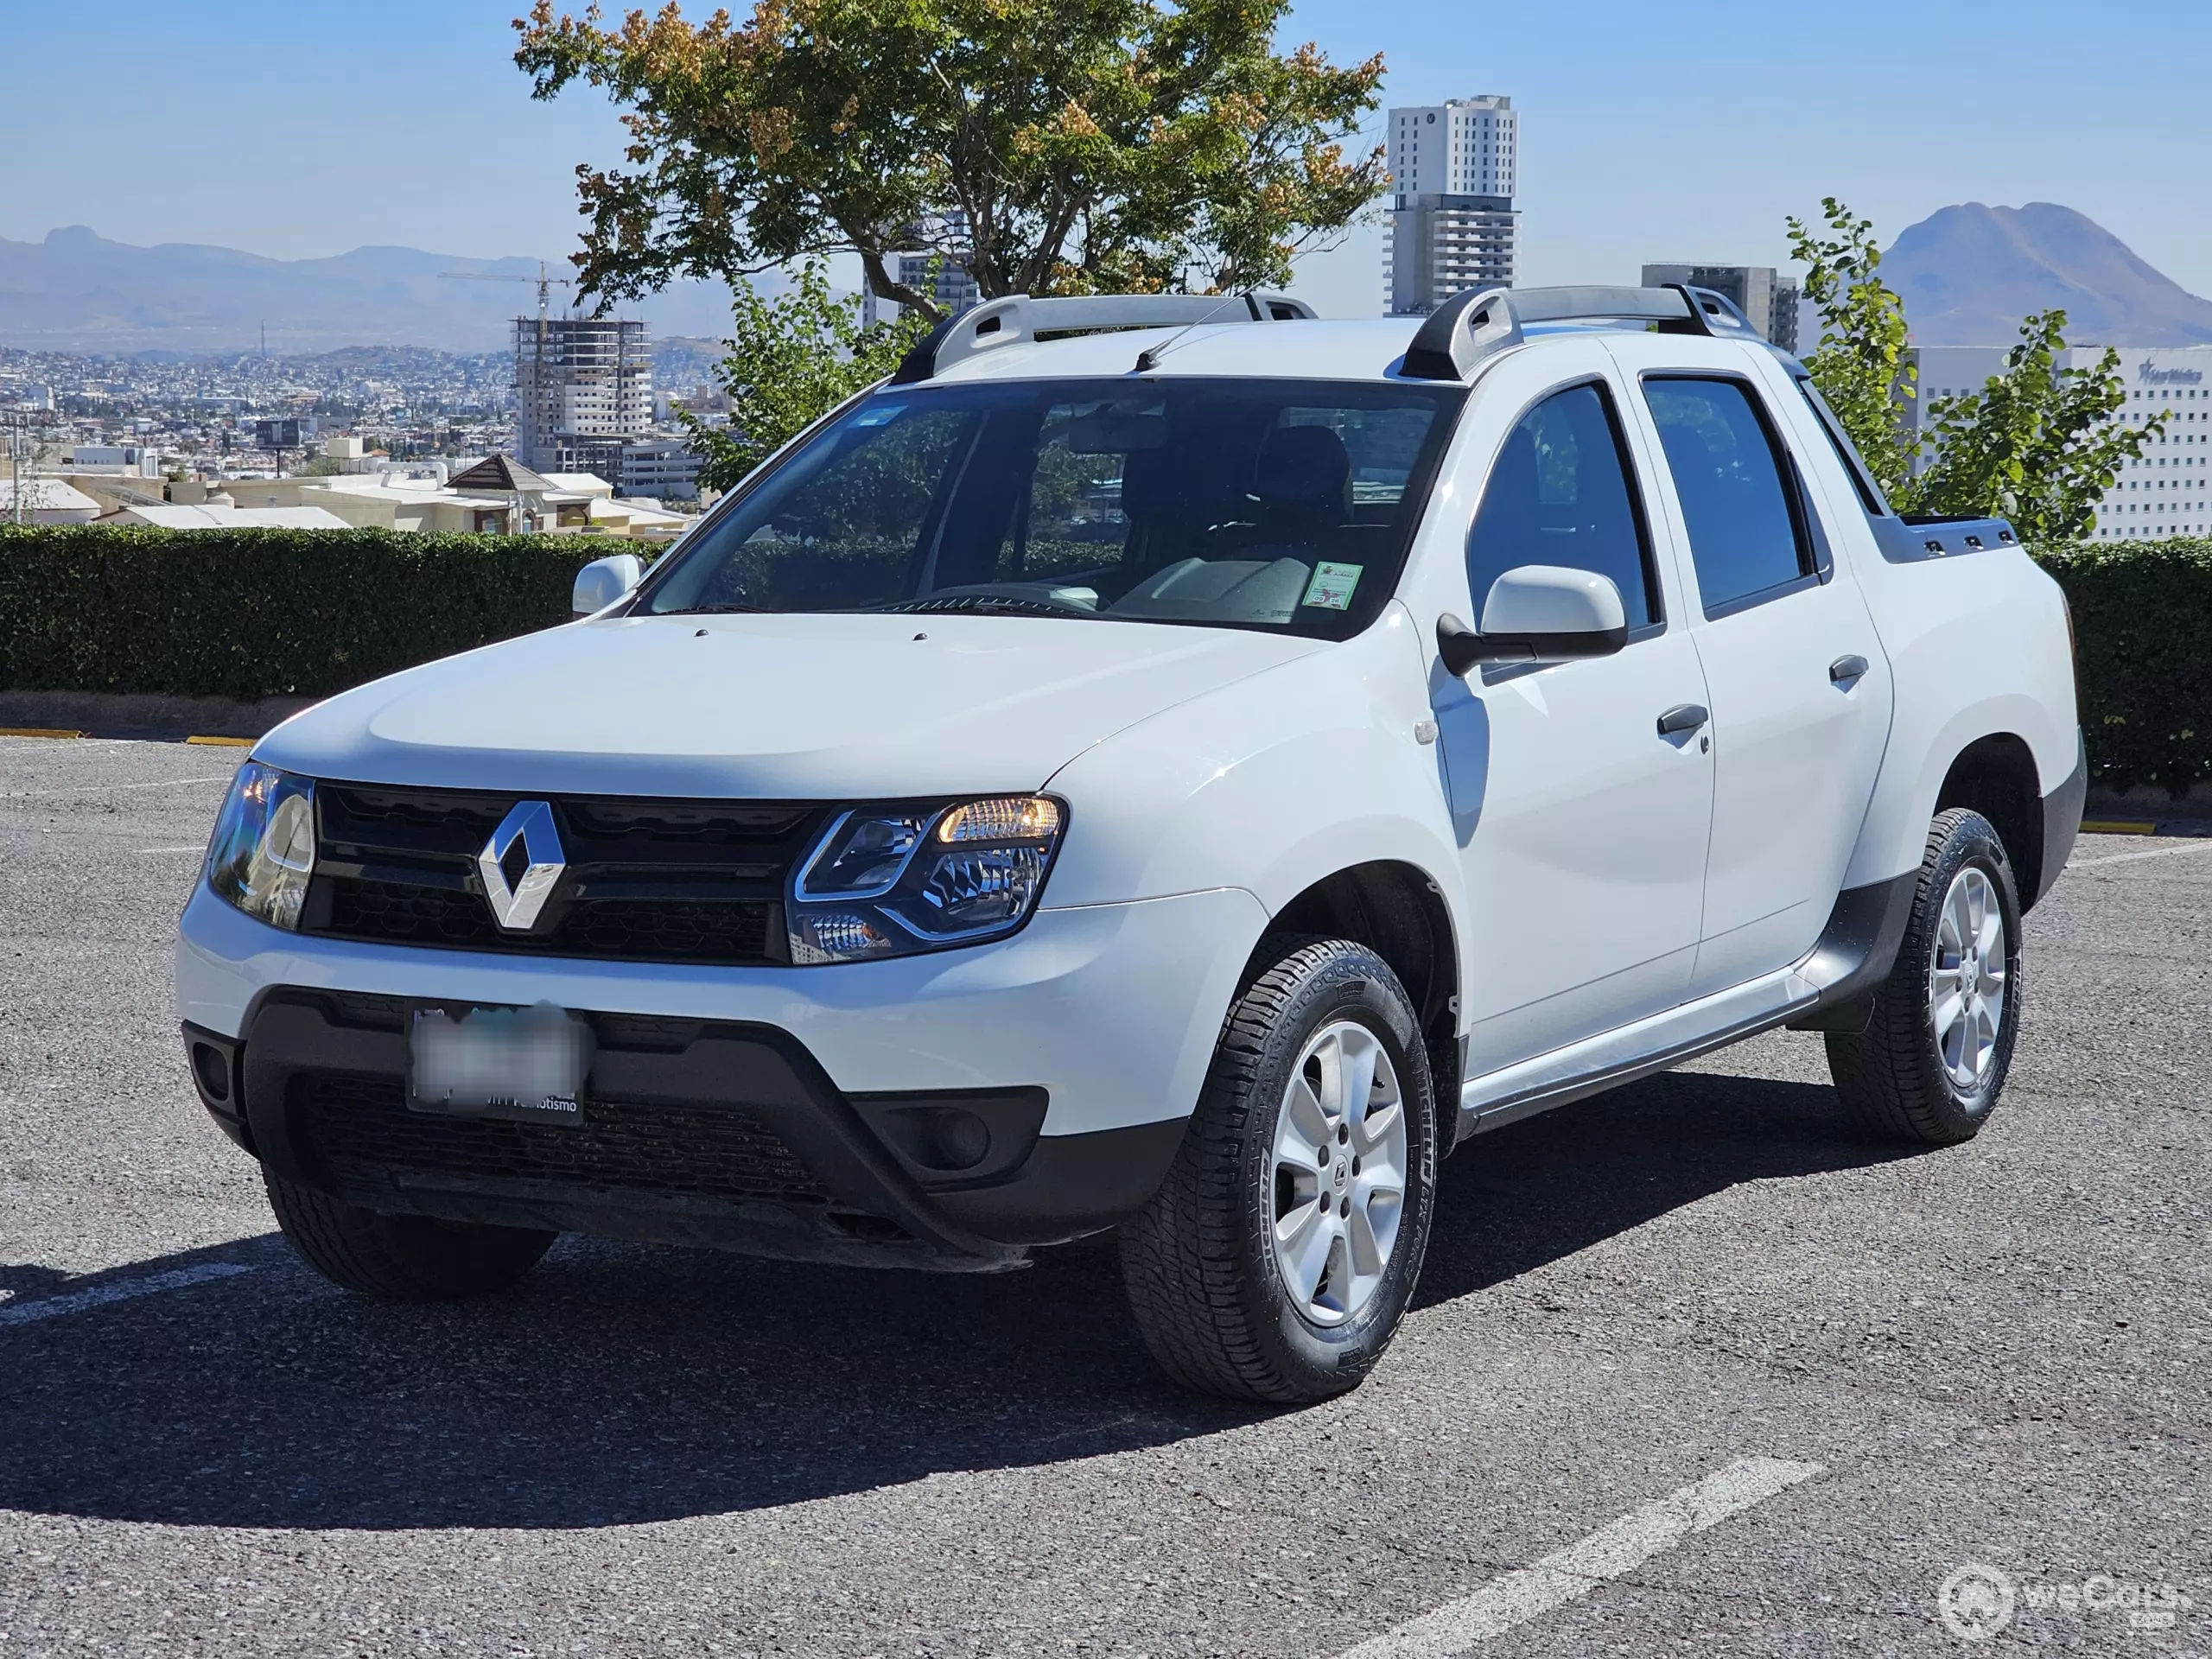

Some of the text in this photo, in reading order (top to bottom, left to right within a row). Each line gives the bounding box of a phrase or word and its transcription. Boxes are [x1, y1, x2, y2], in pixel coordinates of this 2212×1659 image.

[513, 1096, 577, 1113] Potismo
[1414, 1070, 1433, 1183] MICHELIN
[1261, 1157, 1276, 1276] MICHELIN
[1418, 1185, 1430, 1224] LTX
